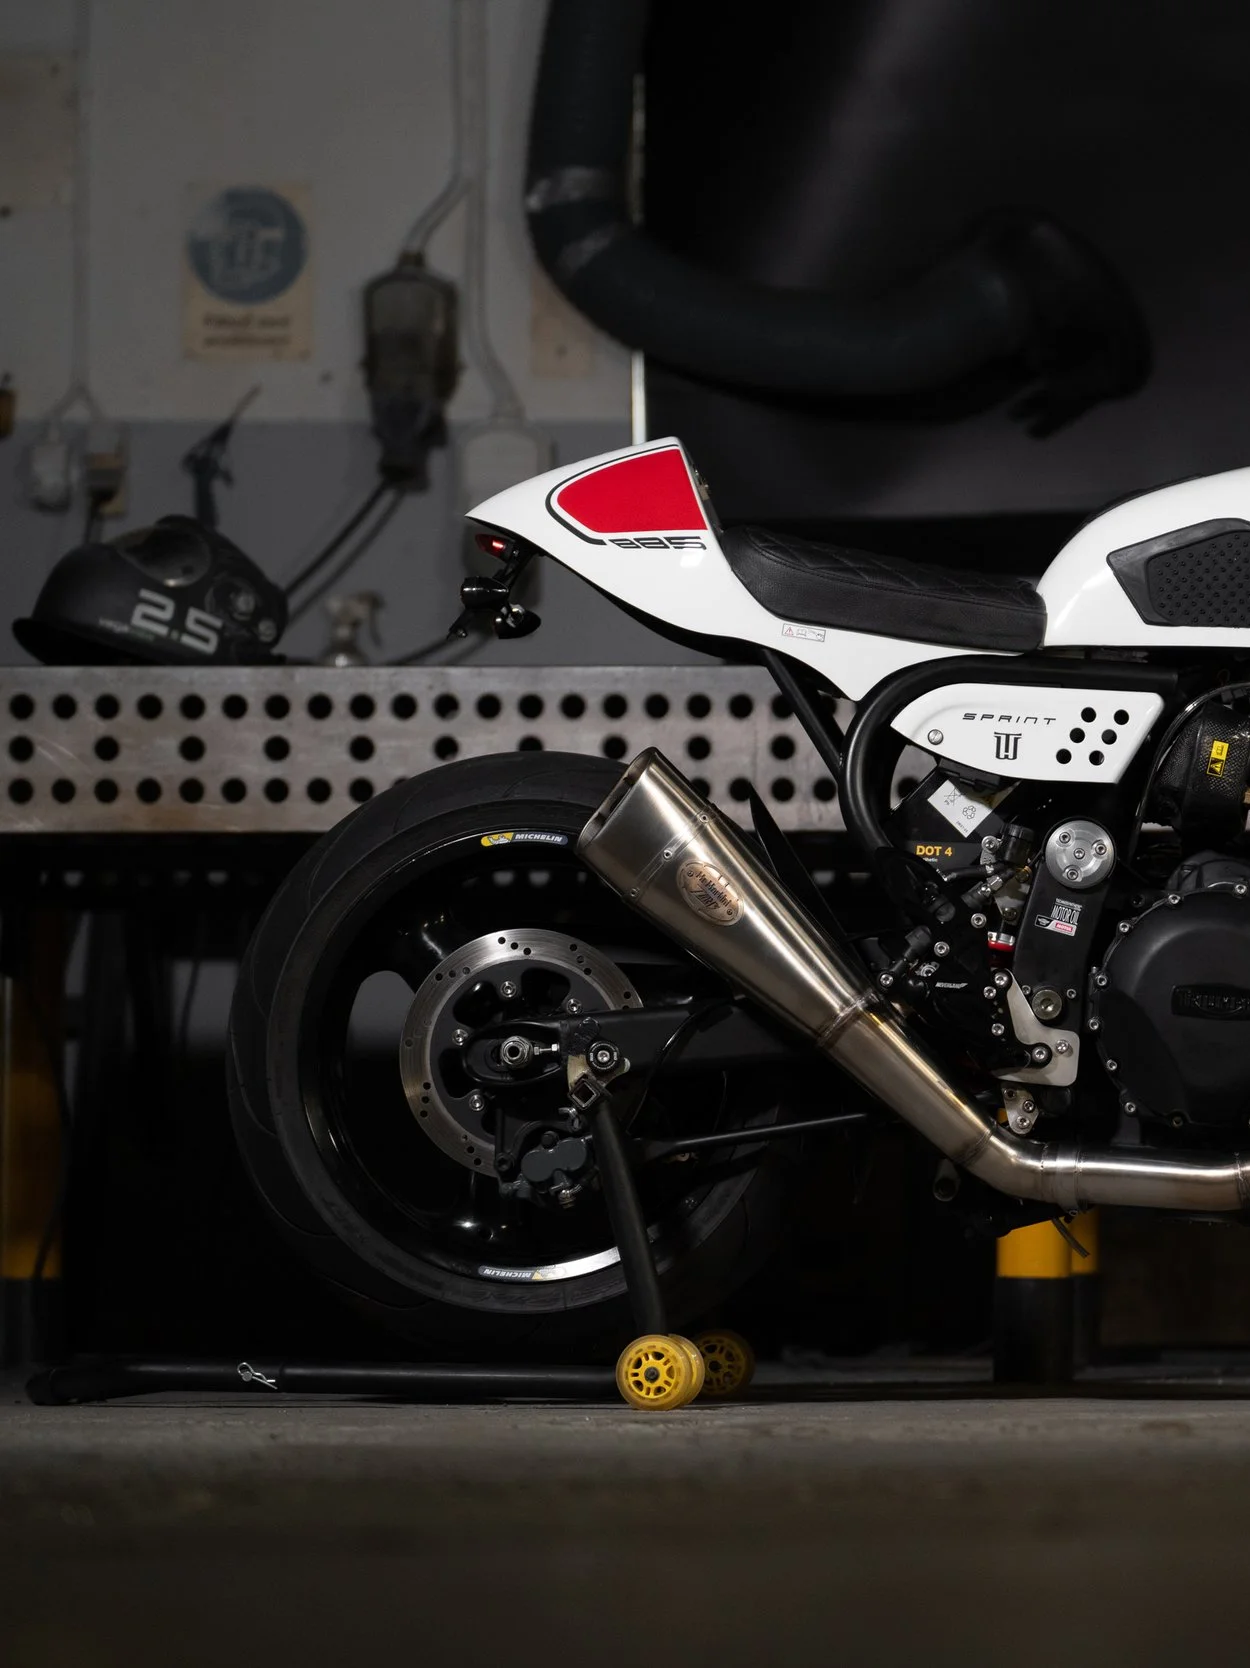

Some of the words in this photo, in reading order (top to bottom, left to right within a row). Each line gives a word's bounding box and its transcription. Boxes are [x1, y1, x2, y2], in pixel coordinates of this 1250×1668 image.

[131, 587, 223, 655] 2.5
[962, 713, 1056, 725] SPRINT
[515, 833, 562, 842] MICHELIN
[916, 845, 942, 856] DOT
[944, 846, 953, 857] 4
[1051, 905, 1072, 923] MOTOR
[484, 1268, 532, 1279] MICHELIN
